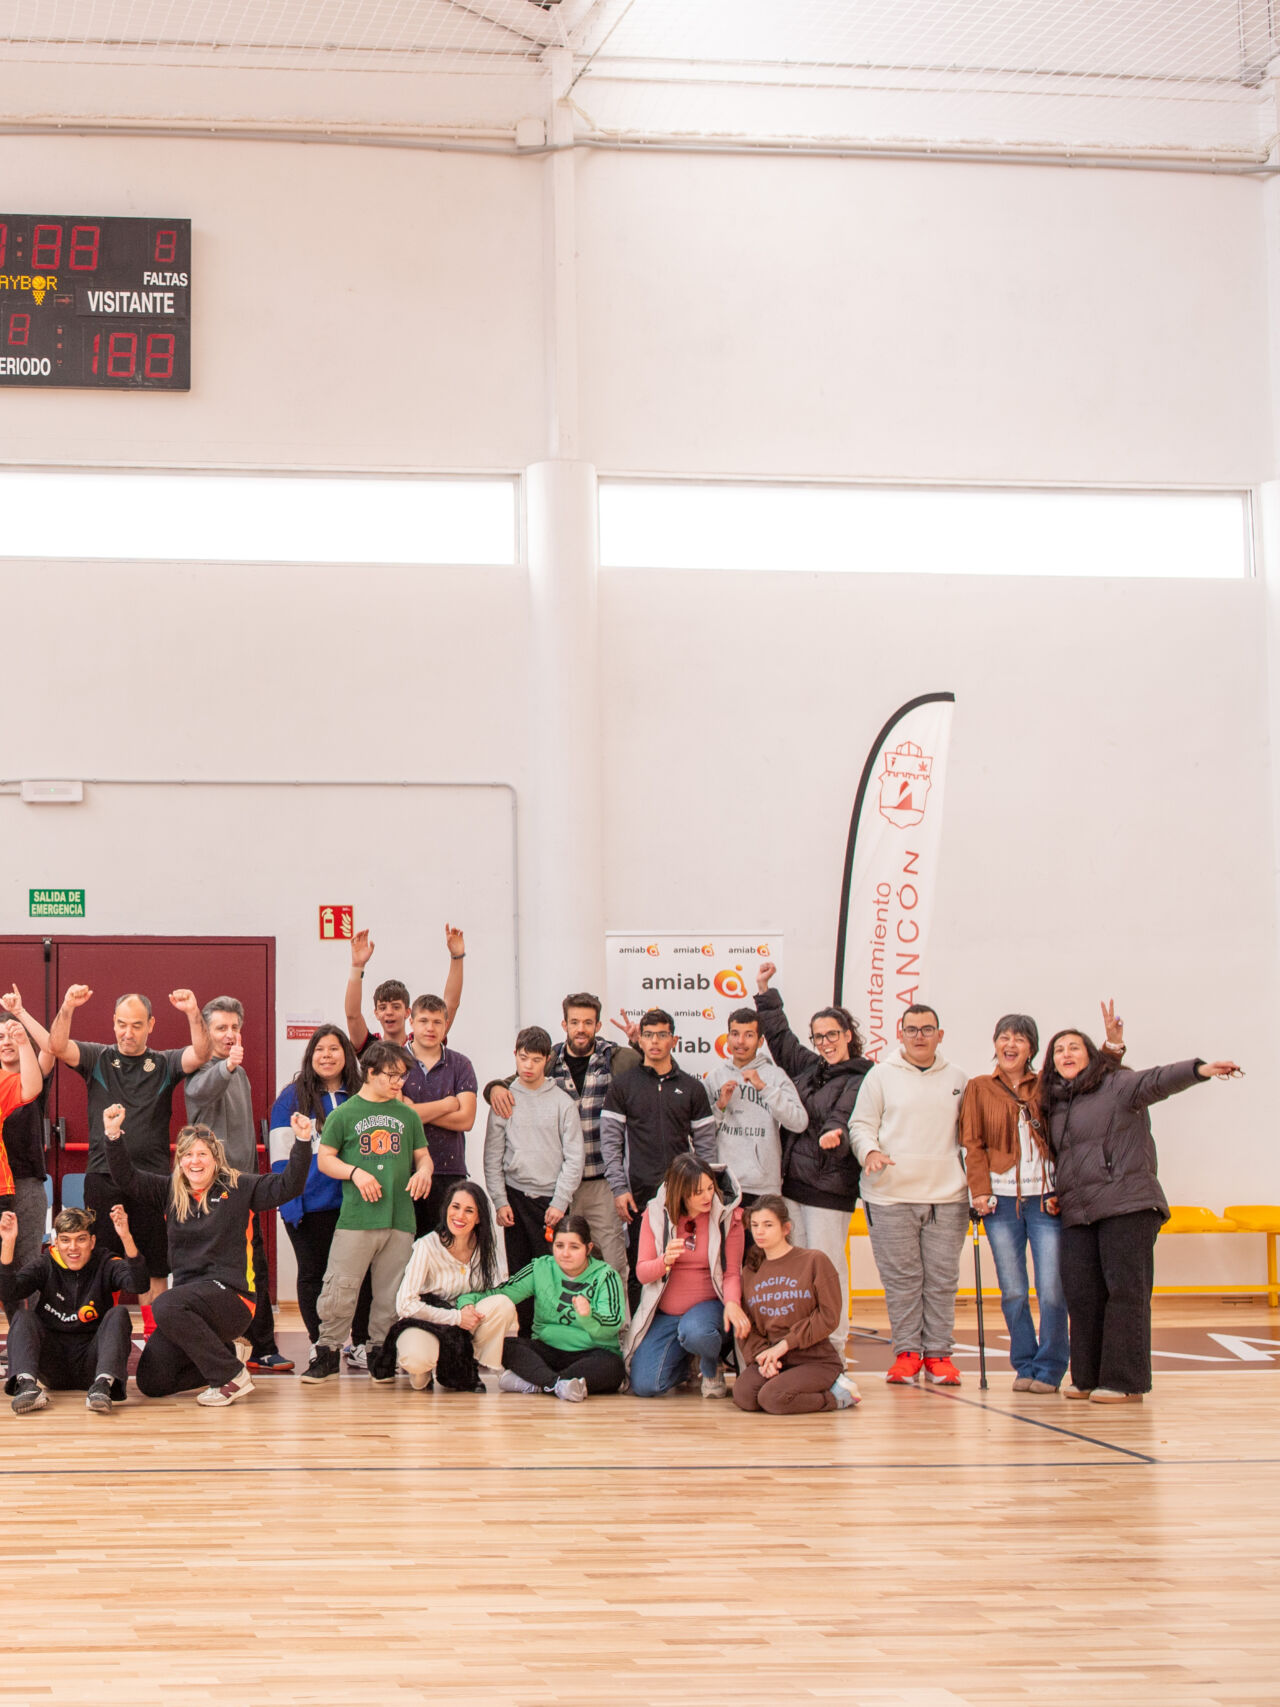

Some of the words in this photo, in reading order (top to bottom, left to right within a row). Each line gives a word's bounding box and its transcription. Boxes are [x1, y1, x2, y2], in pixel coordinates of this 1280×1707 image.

[143, 271, 188, 287] FALTAS
[87, 290, 175, 314] VISITANTE
[33, 891, 67, 902] SALIDA
[68, 891, 81, 902] DE
[31, 903, 83, 915] EMERGENCIA
[619, 945, 646, 954] amiab
[673, 945, 700, 954] amiab
[728, 945, 756, 954] amiab
[896, 850, 921, 1044] ANCÓN
[864, 882, 892, 1065] Ayuntamiento
[641, 973, 711, 990] amiab
[674, 1008, 701, 1017] amiab
[671, 1037, 711, 1054] iab
[355, 1114, 405, 1135] VARSITY
[744, 1127, 766, 1137] CLUB
[754, 1276, 798, 1291] PACIFIC
[759, 1302, 795, 1317] COAST
